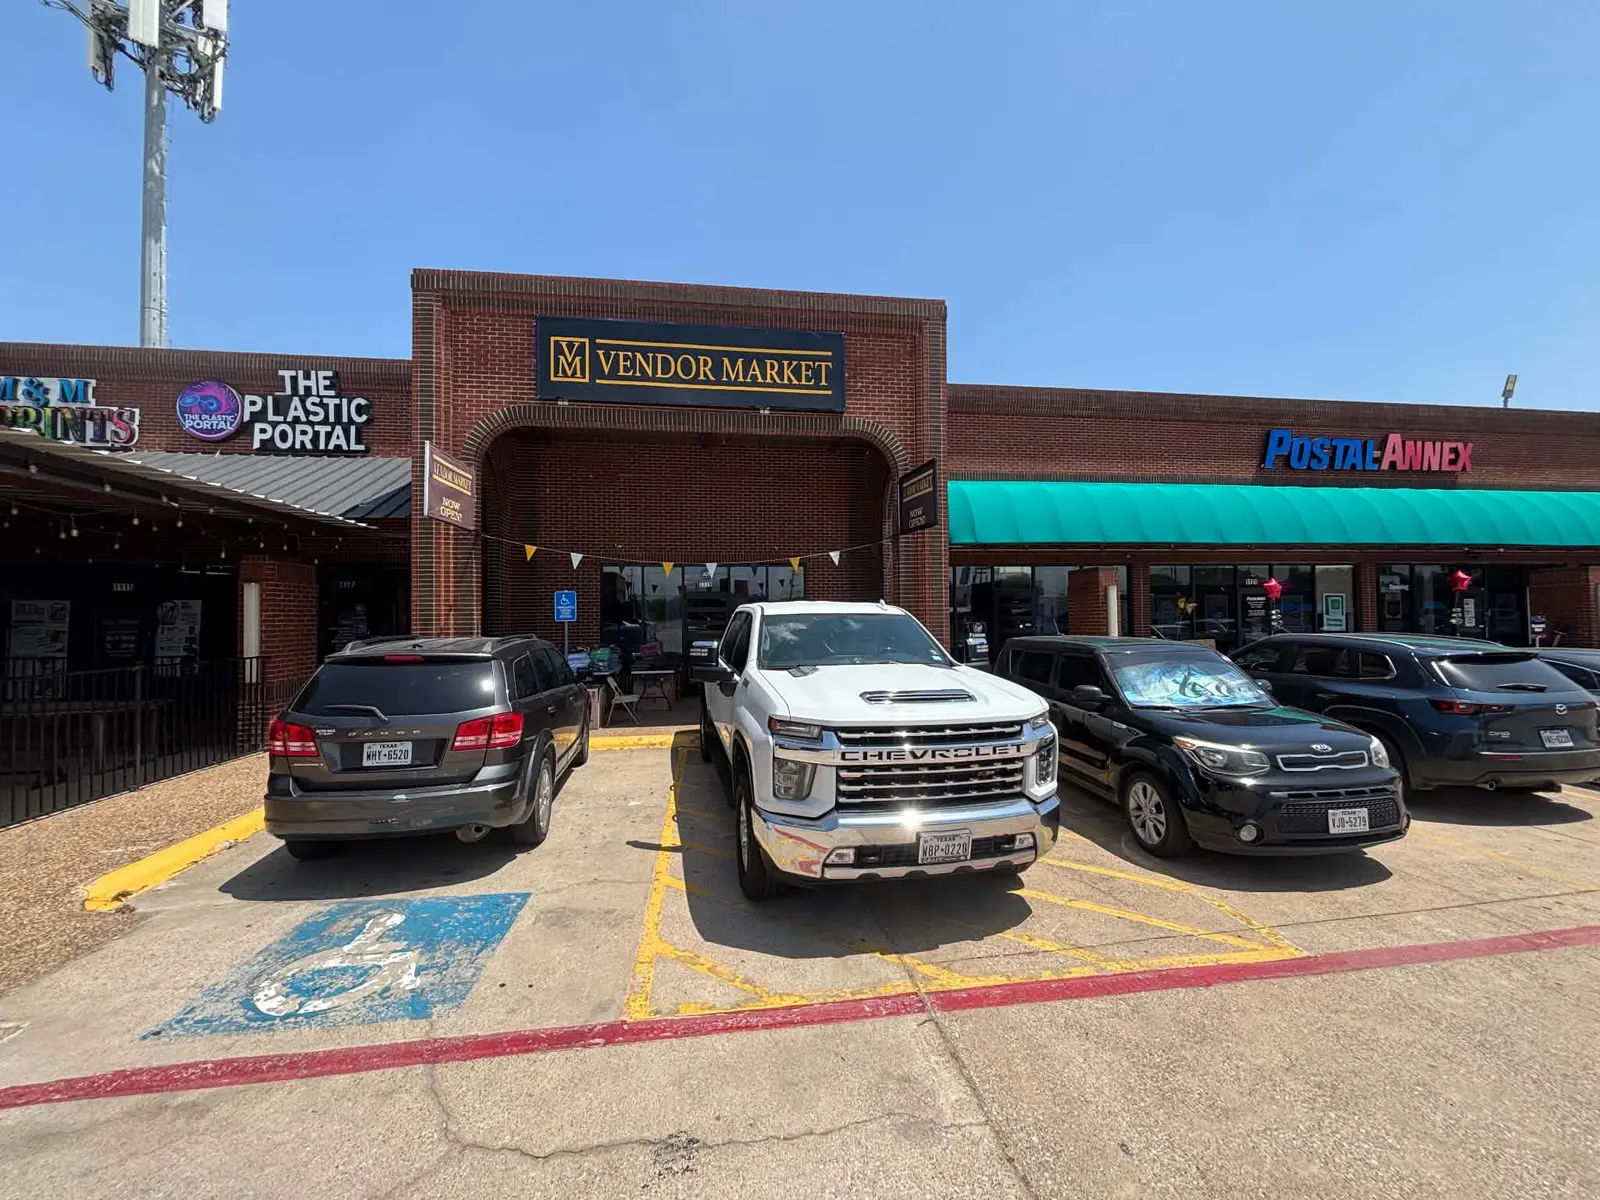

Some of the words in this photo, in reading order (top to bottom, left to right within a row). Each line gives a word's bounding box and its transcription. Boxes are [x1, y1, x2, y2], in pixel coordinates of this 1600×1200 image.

[596, 349, 716, 381] VENDOR
[721, 355, 833, 387] MARKET
[275, 369, 335, 396] THE
[243, 394, 369, 423] PLASTIC
[184, 413, 201, 421] THE
[201, 414, 235, 422] PLASTIC
[185, 420, 234, 431] PORTAL
[252, 422, 366, 451] PORTAL
[443, 497, 461, 511] NOW
[909, 506, 924, 518] NOW
[840, 744, 1026, 761] CHEVROLET
[936, 835, 956, 843] TEXAS
